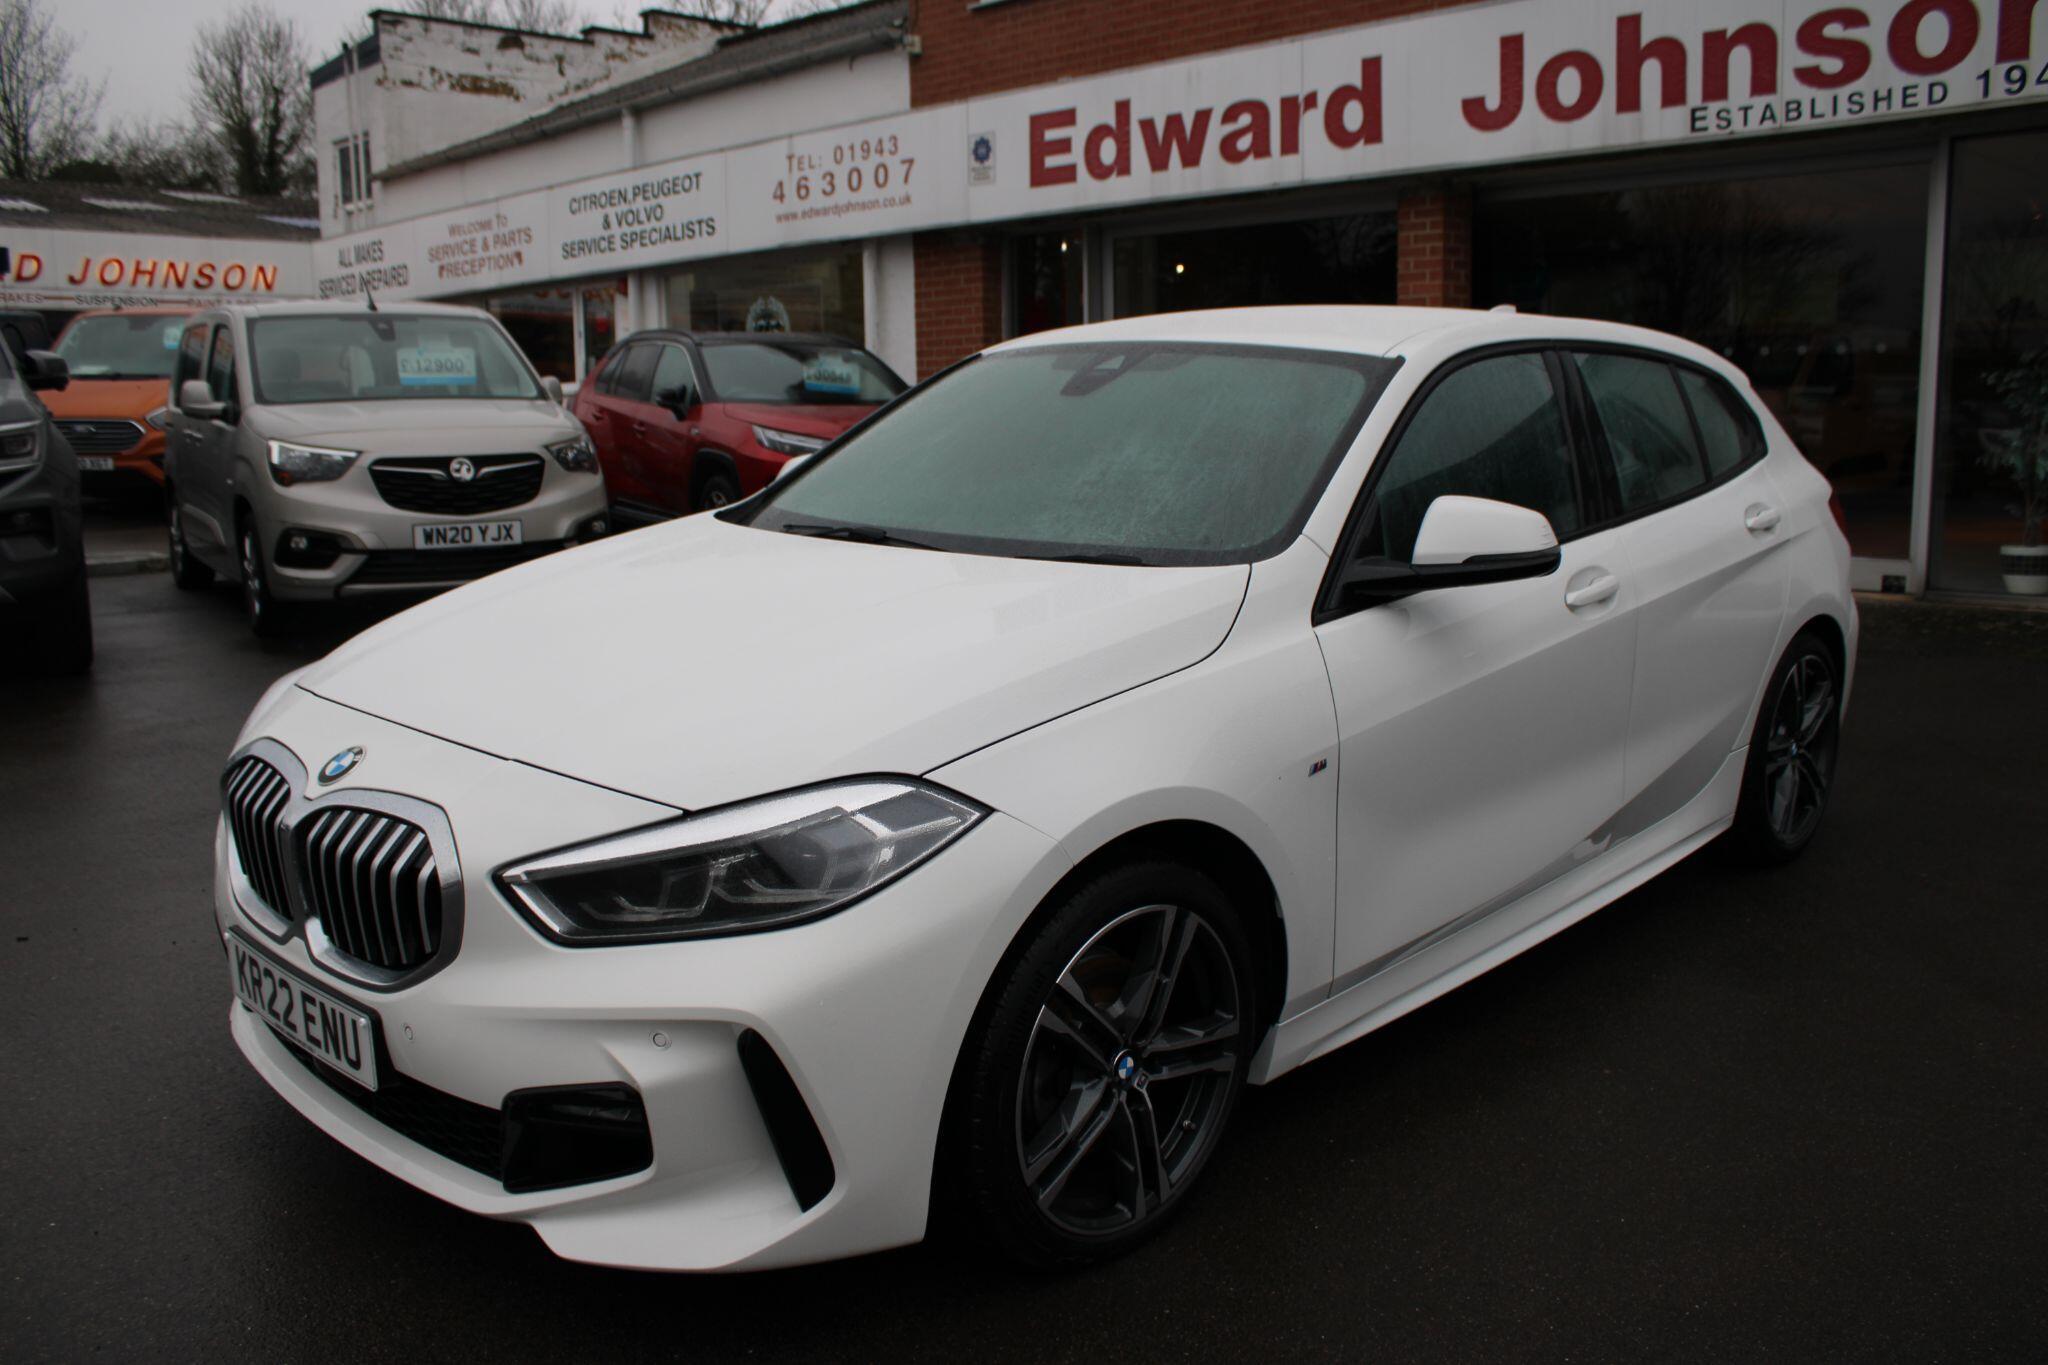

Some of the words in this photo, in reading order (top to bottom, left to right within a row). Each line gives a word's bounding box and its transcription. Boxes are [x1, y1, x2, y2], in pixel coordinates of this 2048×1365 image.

[1029, 55, 1383, 188] Edward
[1690, 81, 1949, 134] ESTABLISHED
[833, 134, 899, 165] 01943
[772, 157, 915, 204] 463007
[602, 213, 611, 230] &
[615, 204, 664, 228] VOLVO
[776, 192, 912, 223] www.edwardjohnson.co.uk
[448, 219, 493, 237] WELCOME
[496, 213, 508, 229] TO
[561, 234, 616, 260] SERVICE
[619, 217, 716, 250] SPECIALISTS
[339, 247, 353, 268] ALL
[354, 239, 383, 265] MAKES
[428, 237, 477, 263] SERVICE
[493, 226, 533, 249] PARTS
[0, 253, 43, 283] D
[68, 257, 278, 291] JOHNSON
[446, 253, 514, 278] RECEPTION
[423, 526, 472, 545] WN20
[479, 524, 513, 542] YJX
[235, 944, 298, 1034] KR22
[302, 992, 362, 1072] ENU
